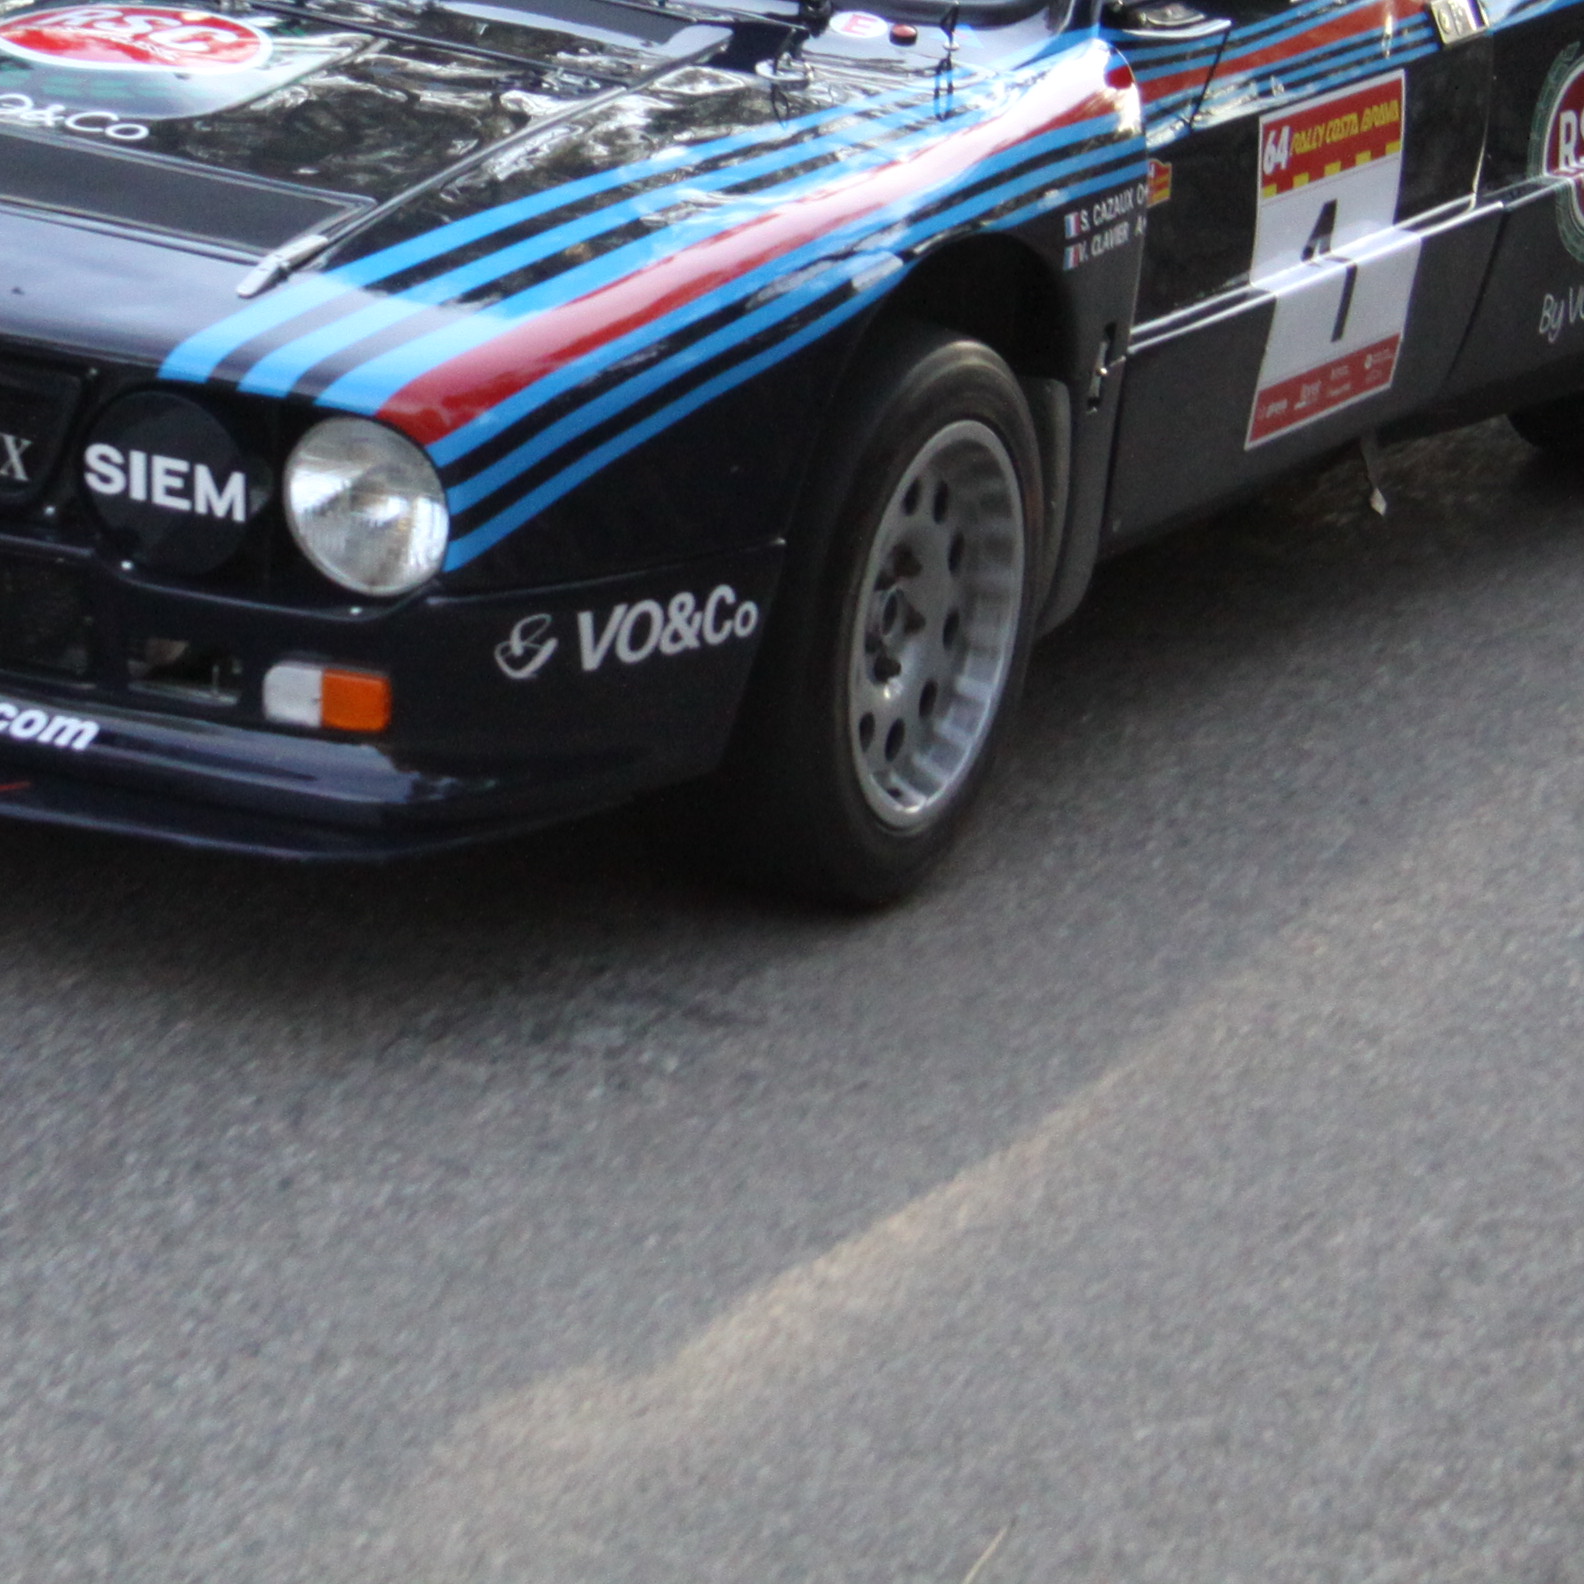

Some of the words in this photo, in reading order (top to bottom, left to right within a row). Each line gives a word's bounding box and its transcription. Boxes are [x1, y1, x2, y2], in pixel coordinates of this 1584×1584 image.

[28, 8, 241, 52] RSC
[1263, 125, 1291, 175] 64
[1539, 293, 1565, 344] By
[83, 442, 246, 524] SIEM
[576, 583, 759, 673] VO&Co
